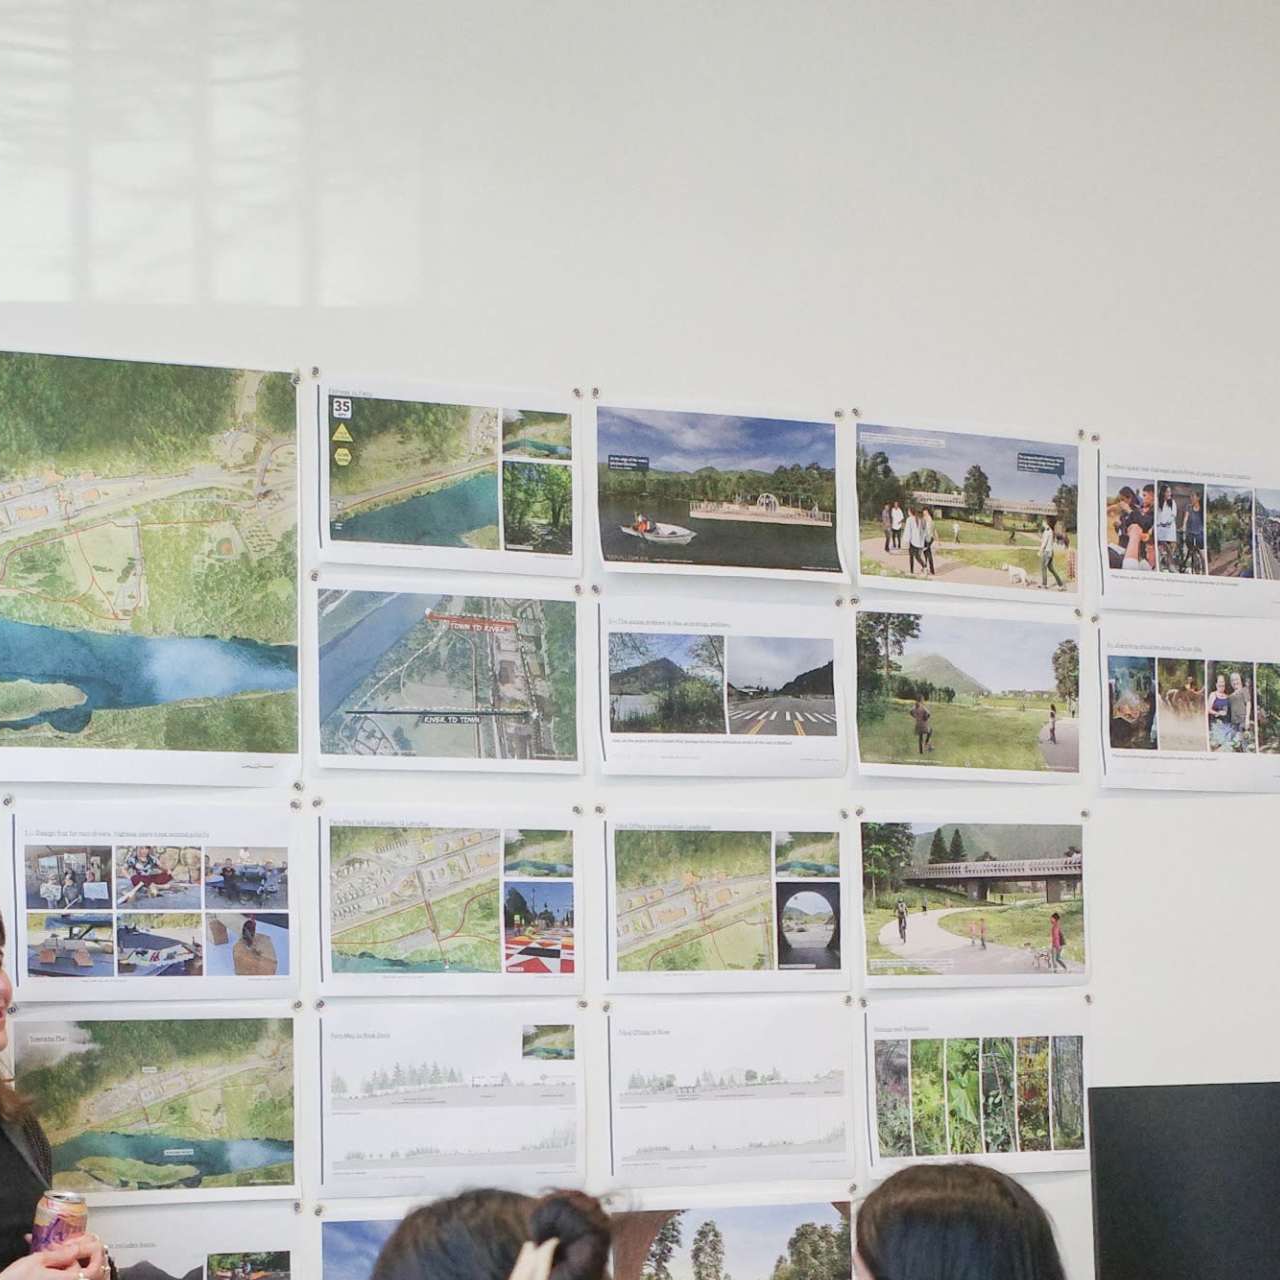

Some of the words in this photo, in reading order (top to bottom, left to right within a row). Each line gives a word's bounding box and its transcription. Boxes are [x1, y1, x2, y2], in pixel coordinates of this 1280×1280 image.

[334, 400, 351, 412] 35
[450, 622, 471, 631] TOWN
[424, 715, 447, 724] RIVER
[448, 715, 458, 723] TO
[460, 715, 480, 724] TOWN
